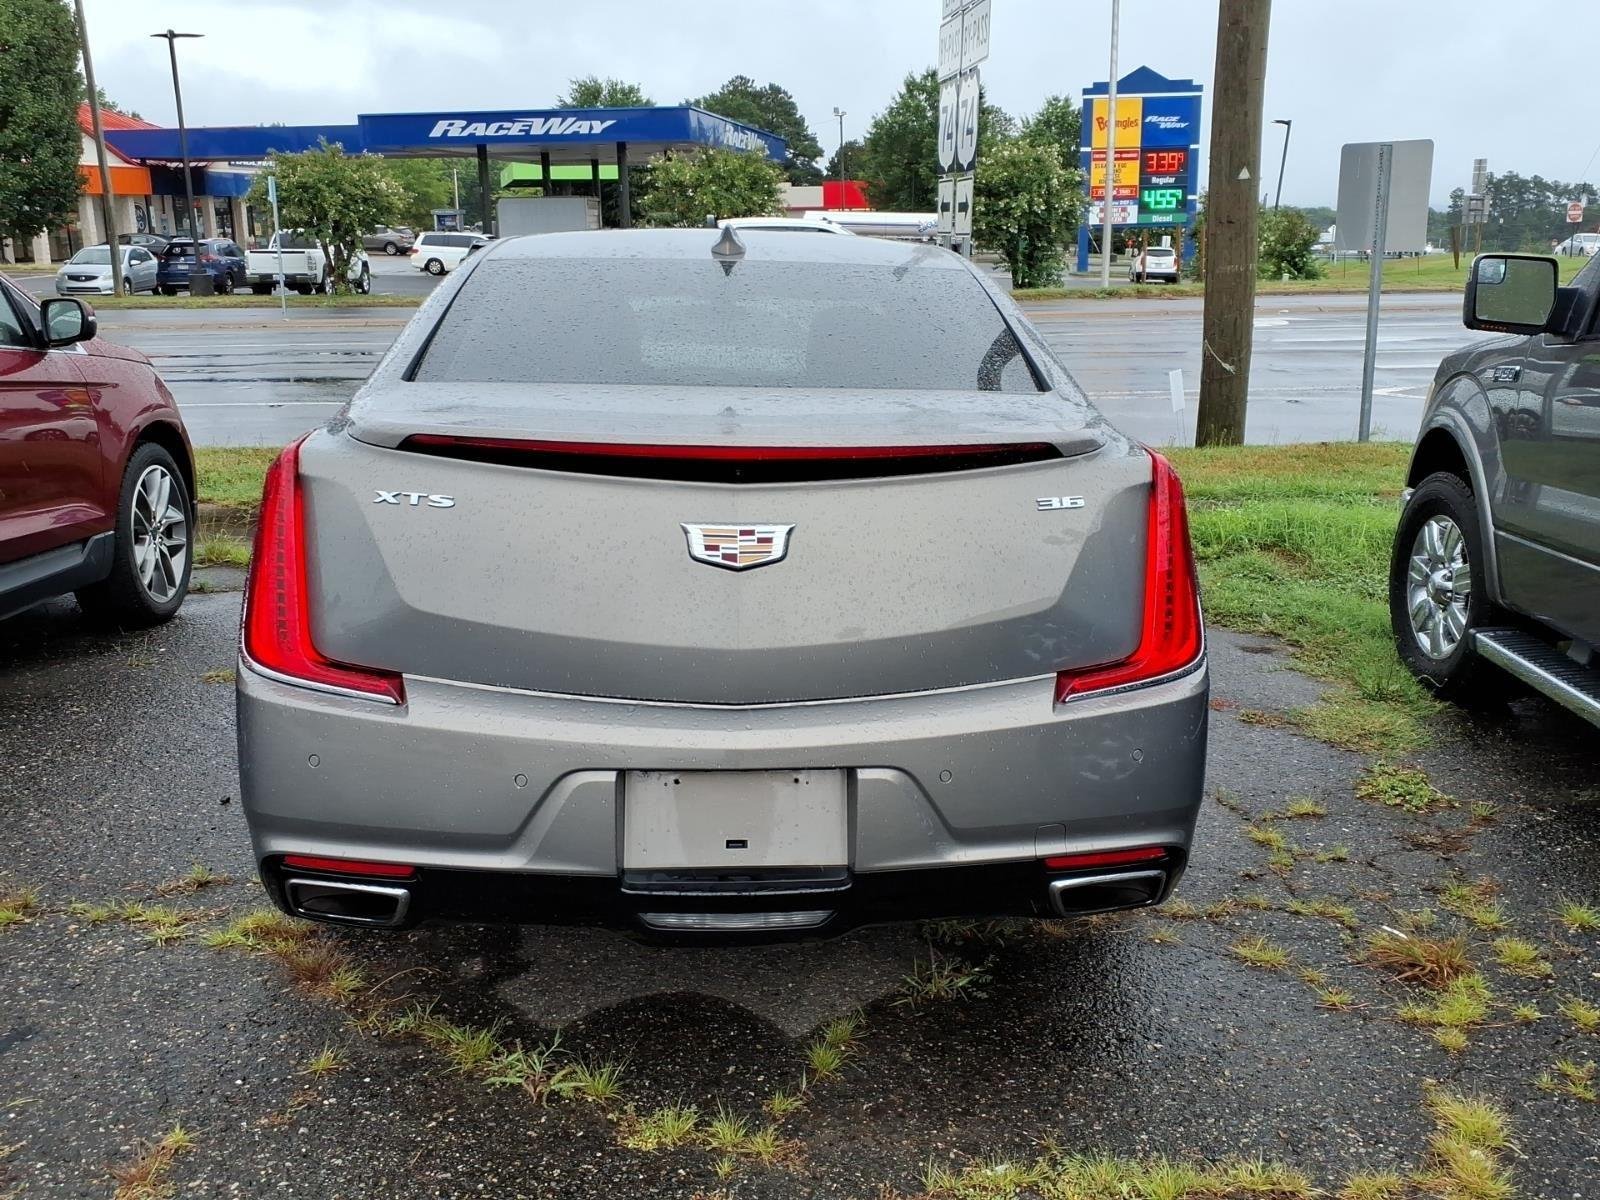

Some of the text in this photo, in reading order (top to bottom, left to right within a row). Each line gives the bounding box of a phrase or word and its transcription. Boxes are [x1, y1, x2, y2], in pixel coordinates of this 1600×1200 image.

[429, 117, 617, 138] RACEWAY
[941, 97, 954, 153] 74
[961, 95, 975, 149] 74
[1151, 176, 1176, 185] Regular
[1152, 214, 1173, 223] Diesel
[373, 490, 456, 508] XTS
